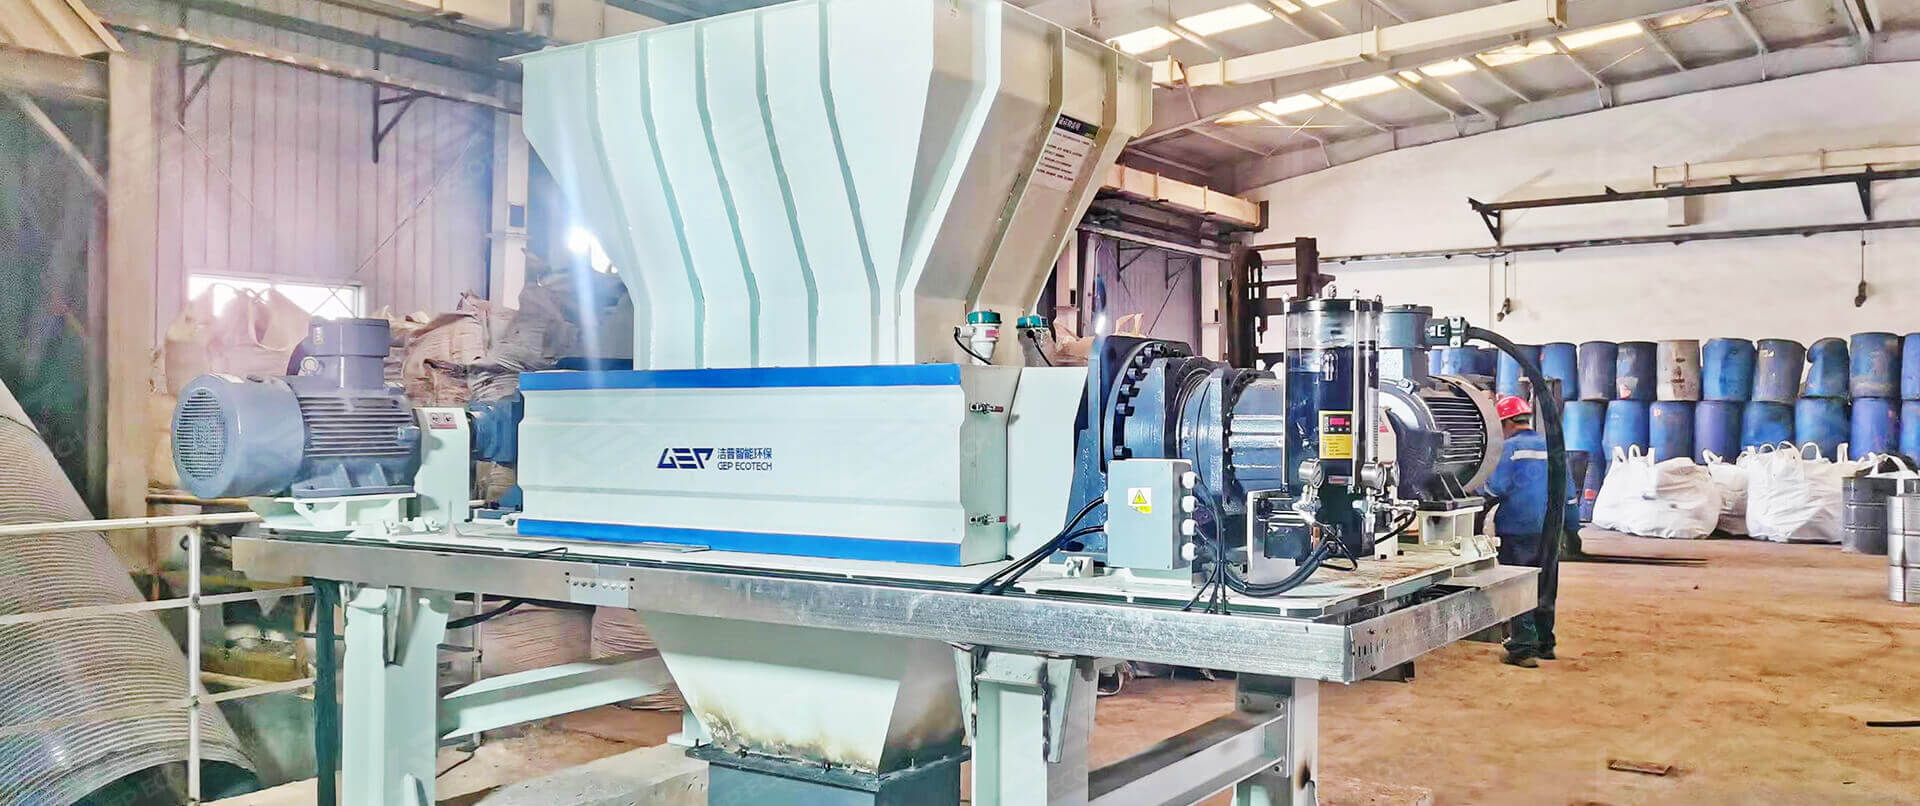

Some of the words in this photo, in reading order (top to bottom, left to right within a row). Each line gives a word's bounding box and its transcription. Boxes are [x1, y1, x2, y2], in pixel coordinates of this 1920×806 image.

[657, 448, 714, 469] GEP
[717, 447, 772, 460] 洁普智能环保
[717, 462, 733, 471] GEP
[735, 462, 773, 471] ECOTECH
